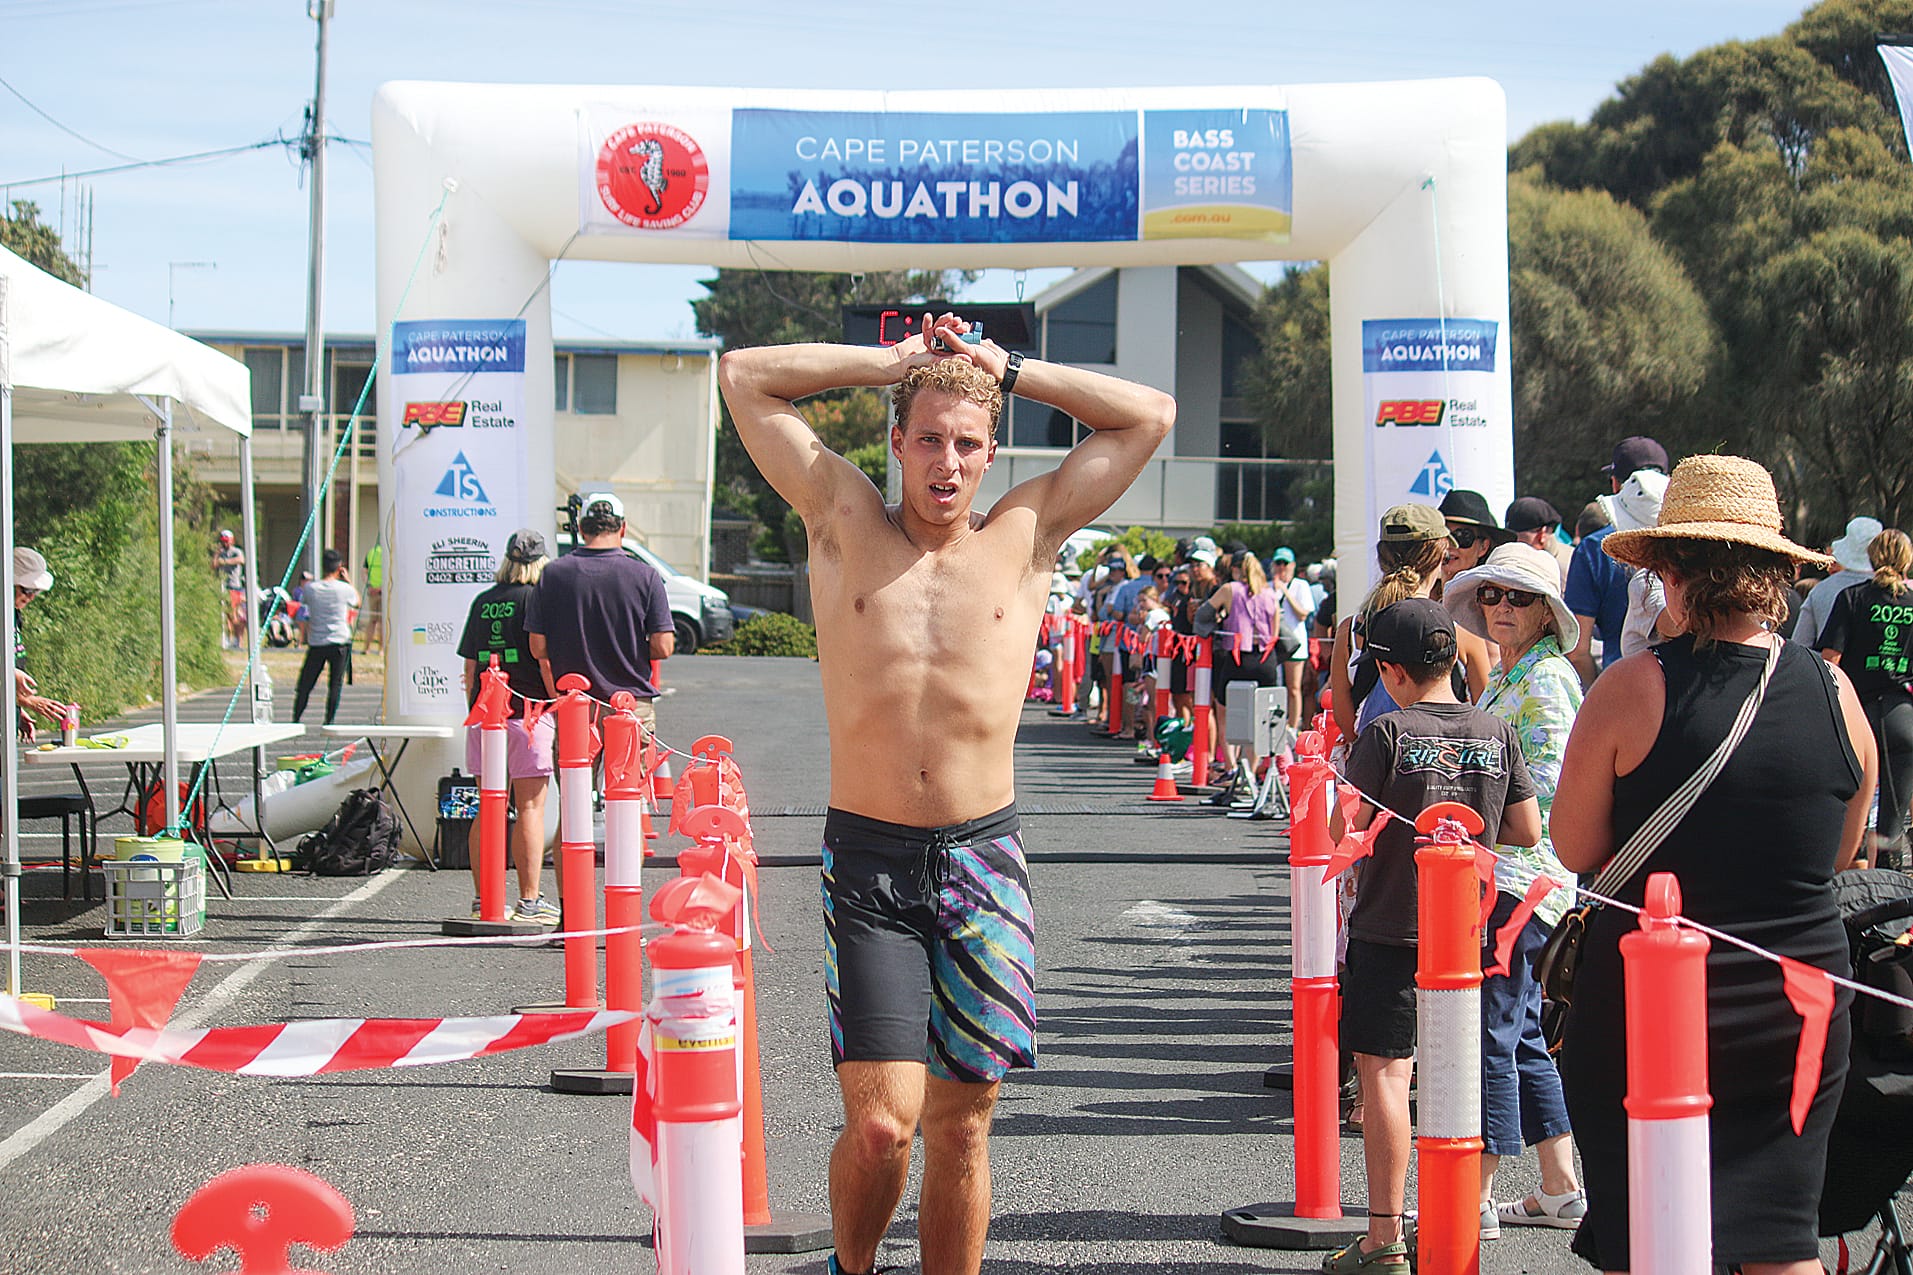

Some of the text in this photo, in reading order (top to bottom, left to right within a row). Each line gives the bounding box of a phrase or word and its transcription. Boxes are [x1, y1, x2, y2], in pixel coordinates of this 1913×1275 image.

[1173, 130, 1234, 149] BASS
[796, 137, 1079, 164] CAPE PATERSON
[1173, 152, 1256, 172] COAST
[1174, 176, 1256, 195] SERIES
[792, 179, 1079, 218] AQUATHON
[617, 208, 642, 227] LIFE
[1170, 213, 1231, 225] .com.au
[408, 330, 508, 342] CAPE PATERSON
[1381, 329, 1480, 340] CAPE PATERSON
[407, 346, 508, 363] AQUATHON
[1381, 345, 1480, 361] AQUATHON
[471, 400, 502, 412] Real
[1449, 400, 1477, 411] Real
[1375, 400, 1445, 427] PBE
[472, 416, 515, 428] Estate
[1450, 415, 1487, 427] Estate
[450, 463, 480, 500] TS
[423, 507, 497, 518] CONSTRUCTIONS
[431, 537, 488, 550] ELI SHEERIN
[426, 556, 496, 571] CONCRETING
[428, 573, 494, 582] 0402 632 529
[481, 602, 515, 619] 2025
[1870, 604, 1913, 625] 2025
[427, 622, 454, 633] BASS
[427, 633, 453, 641] COAST
[419, 666, 439, 676] The
[412, 671, 449, 687] Cape
[417, 686, 449, 698] tavern
